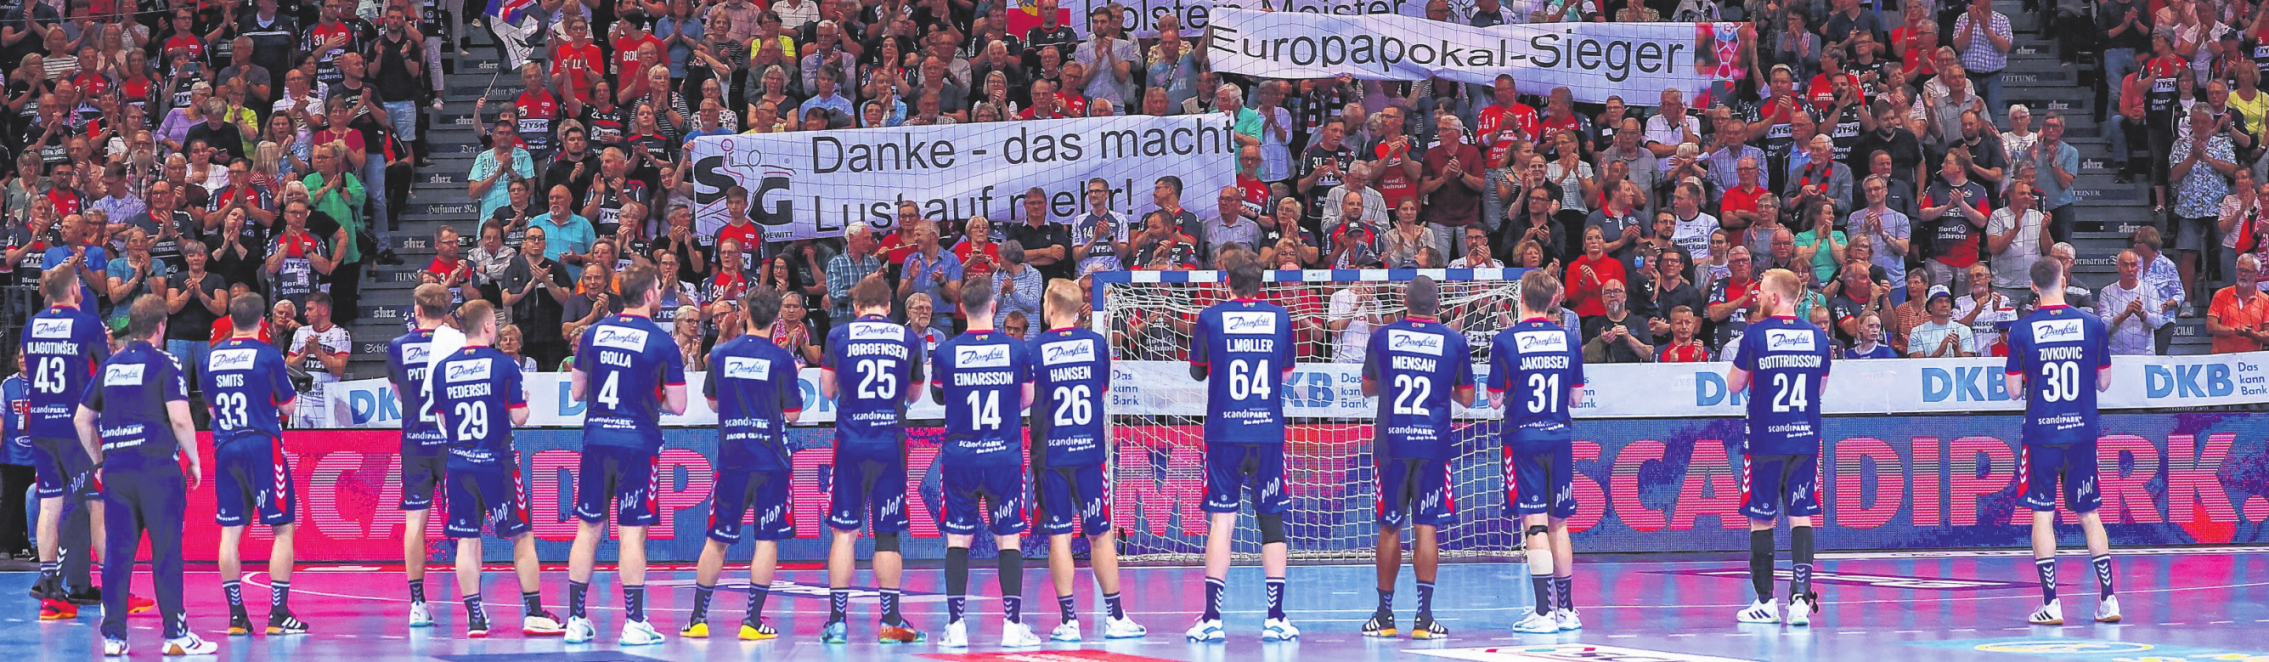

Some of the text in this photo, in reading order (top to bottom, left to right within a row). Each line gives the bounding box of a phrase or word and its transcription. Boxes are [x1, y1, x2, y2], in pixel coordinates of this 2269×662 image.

[314, 34, 325, 45] 31
[1207, 25, 1684, 82] Europapokal-Sieger
[813, 132, 955, 174] Danke
[1004, 127, 1083, 162] das
[1101, 118, 1236, 158] macht
[925, 185, 994, 221] auf
[395, 272, 417, 281] FLENS
[600, 351, 632, 368] GOLLA
[847, 343, 908, 360] JØRGENSEN
[2039, 347, 2082, 362] ZIVKOVIC
[1392, 356, 1437, 373] MENSAH
[1520, 356, 1569, 371] JAKOBSEN
[1758, 355, 1822, 369] GOTTFRIDSSON
[2238, 362, 2258, 372] Das
[34, 356, 66, 394] 43
[215, 374, 244, 388] SMITS
[857, 359, 896, 399] 25
[954, 371, 1014, 387] EINARSSON
[1050, 366, 1091, 382] HANSEN
[1113, 369, 1132, 380] Das
[1229, 359, 1271, 400] 64
[1341, 372, 1362, 383] Das
[2042, 361, 2079, 402] 30
[2145, 363, 2234, 399] DKB
[2240, 374, 2265, 384] kann
[447, 383, 491, 400] PEDERSEN
[598, 371, 619, 409] 4
[1113, 384, 1138, 394] kann
[1341, 387, 1361, 396] kan
[1772, 373, 1808, 412] 24
[1922, 366, 2010, 402] DKB
[2241, 385, 2268, 395] Bank
[1113, 396, 1139, 406] Bank
[1393, 374, 1431, 416] 22
[1527, 373, 1559, 413] 31
[215, 391, 248, 430] 33
[967, 390, 1001, 430] 14
[1053, 385, 1092, 426] 26
[1341, 399, 1368, 409] Bank
[455, 401, 488, 441] 29
[102, 426, 145, 438] candiPARK
[1262, 477, 1280, 503] plop
[1567, 432, 2269, 532] SCADIPRK.
